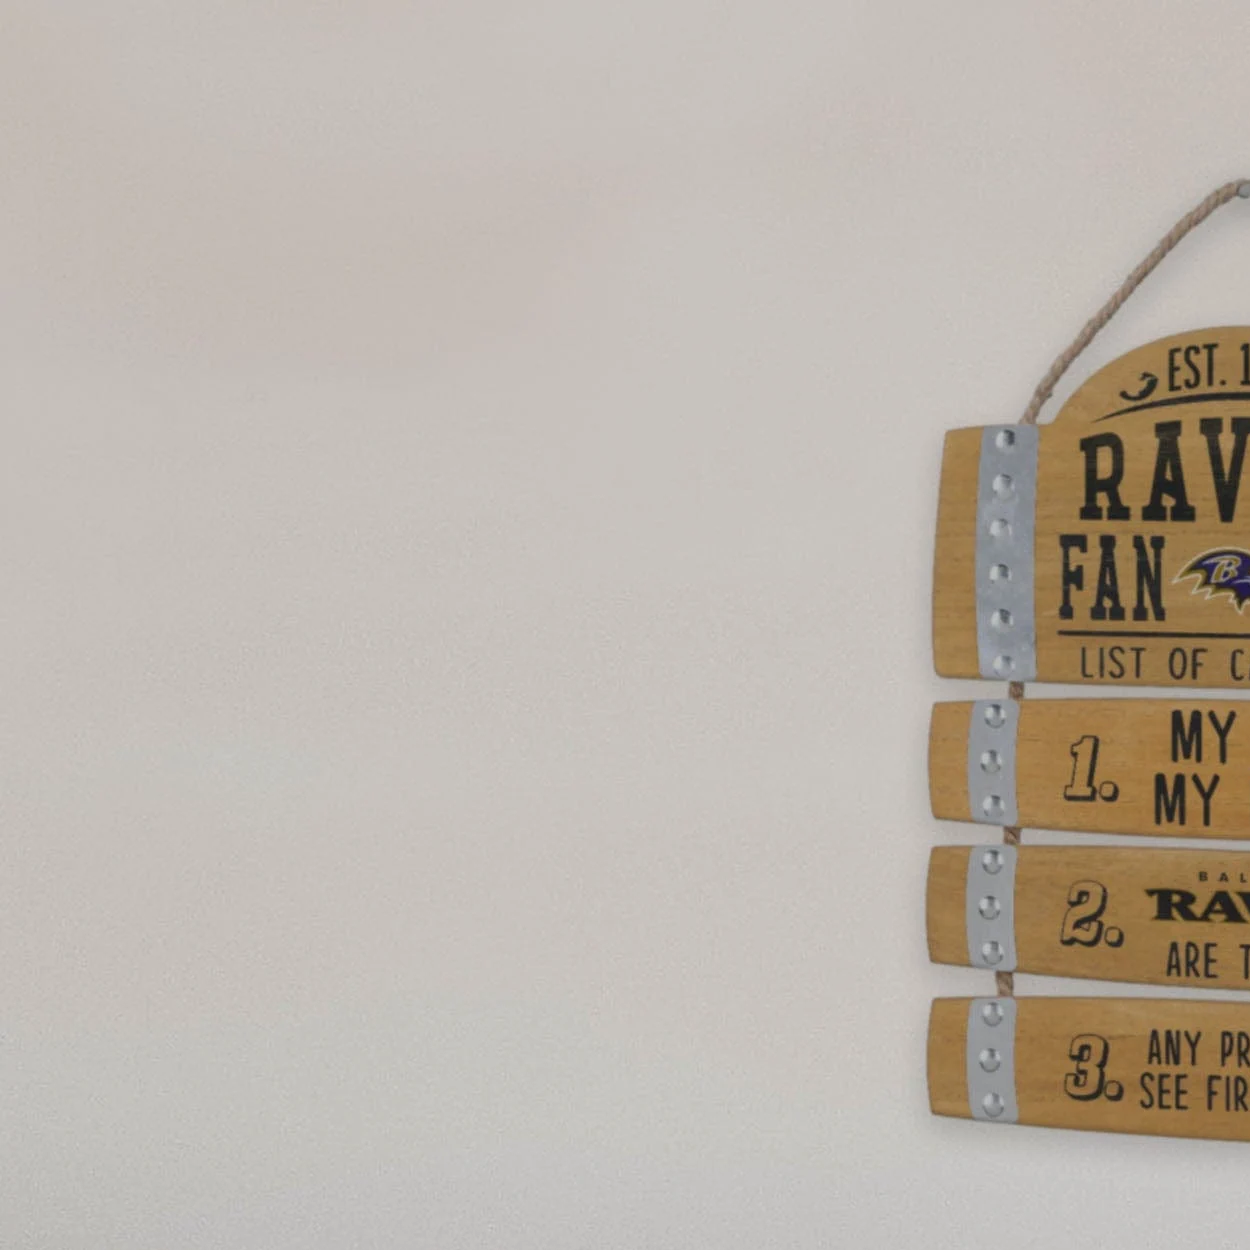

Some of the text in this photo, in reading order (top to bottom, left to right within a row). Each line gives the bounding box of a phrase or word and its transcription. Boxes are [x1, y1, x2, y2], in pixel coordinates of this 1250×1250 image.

[1168, 343, 1226, 391] EST.
[1058, 534, 1165, 620] FAN
[1081, 646, 1146, 679] LIST
[1168, 648, 1208, 680] OF
[1171, 710, 1237, 764] MY
[1063, 735, 1119, 801] 1.
[1154, 773, 1220, 827] MY
[1060, 880, 1124, 947] 2.
[1166, 941, 1218, 978] ARE
[1064, 1033, 1124, 1101] 3.
[1147, 1029, 1202, 1066] ANY
[1140, 1073, 1189, 1110] SEE
